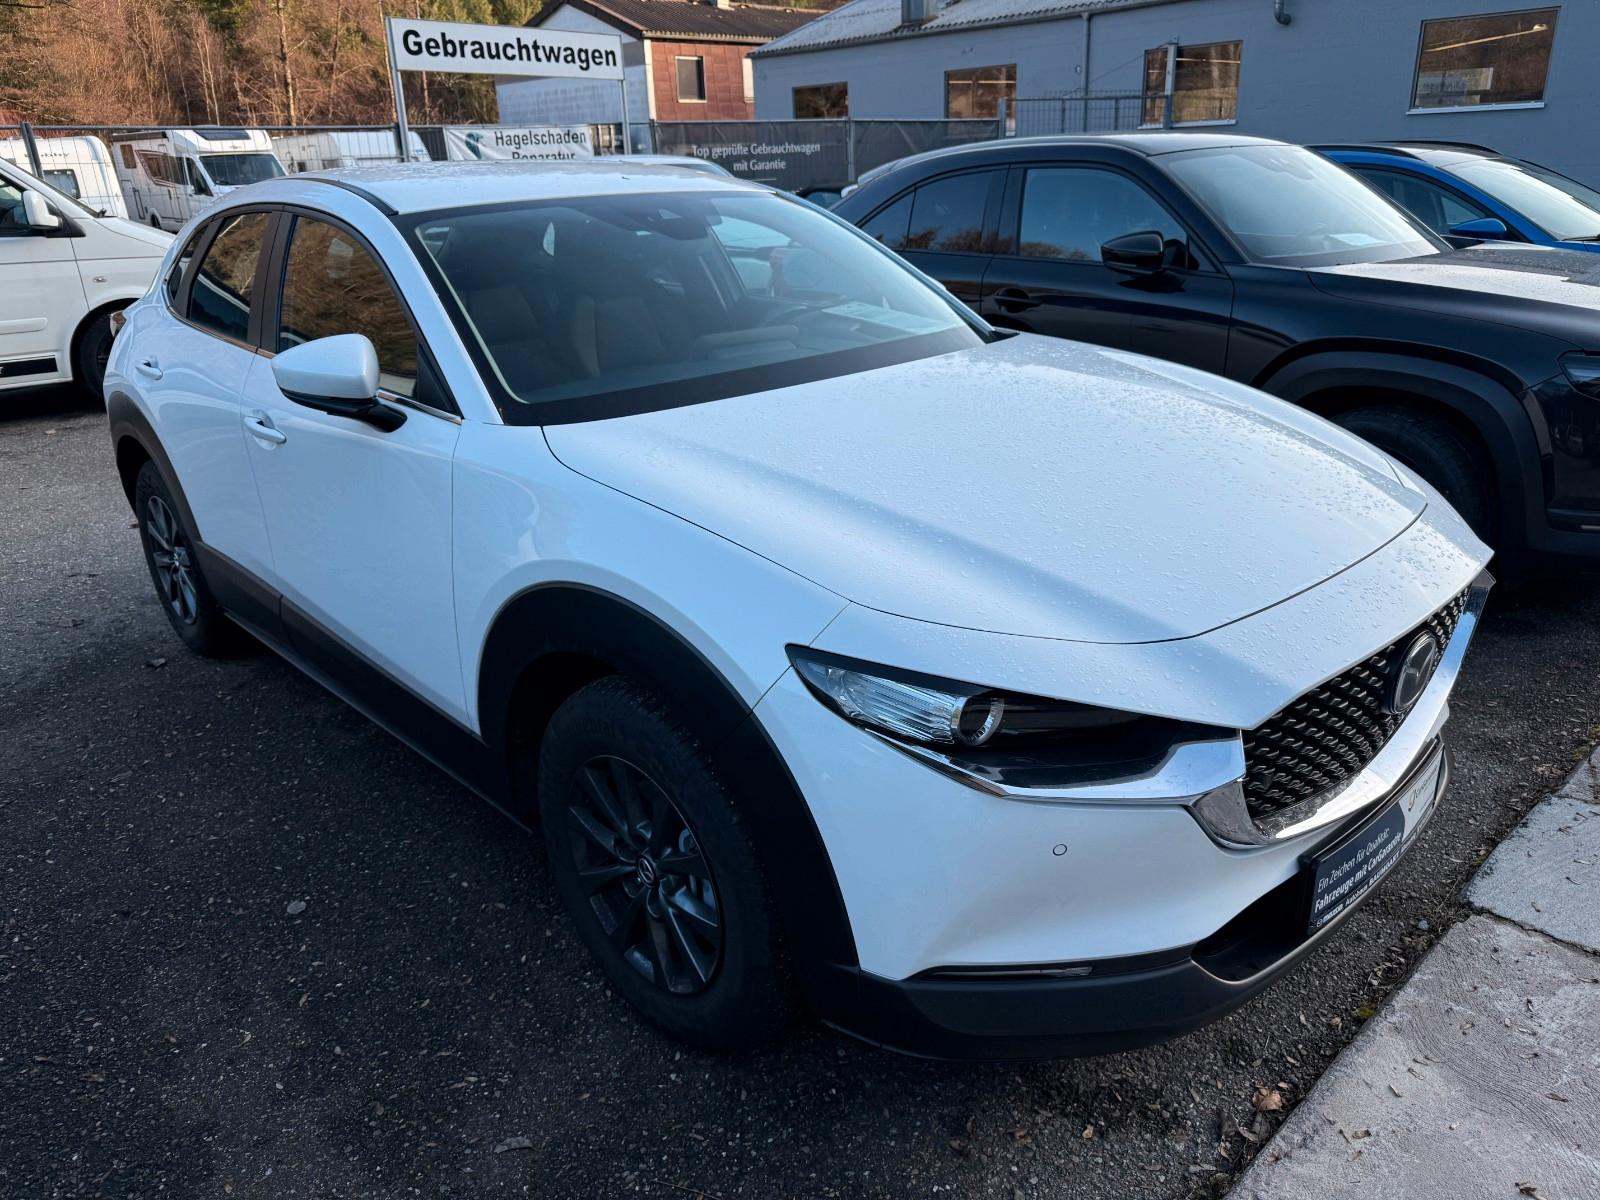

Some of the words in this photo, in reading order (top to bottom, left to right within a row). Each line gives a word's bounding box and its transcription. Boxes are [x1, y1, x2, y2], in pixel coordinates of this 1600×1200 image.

[402, 29, 617, 71] Gebrauchtwagen
[494, 129, 587, 149] Hagelschaden
[691, 145, 709, 158] Top
[712, 144, 748, 158] geprüfte
[750, 142, 820, 155] Gebrauchtwagen
[733, 160, 748, 171] mit
[750, 159, 786, 171] Garantie
[1317, 877, 1329, 893] Ein
[1329, 857, 1355, 884] Zeichen
[1356, 848, 1366, 864] für
[1314, 876, 1354, 914] Fahrzeuge
[1355, 864, 1368, 883] mit
